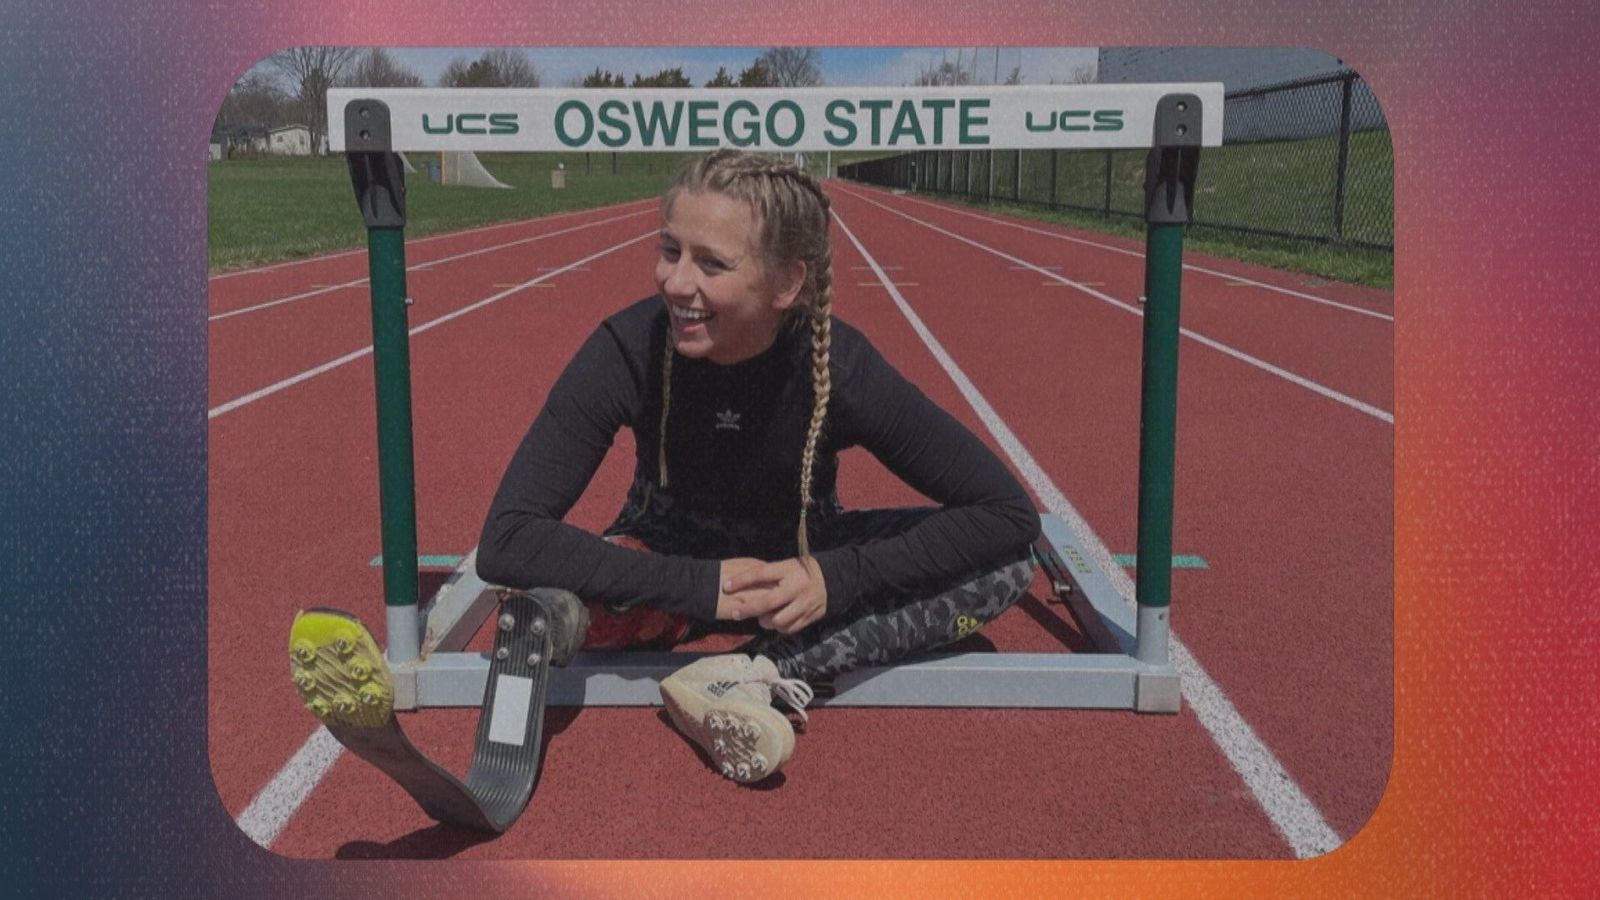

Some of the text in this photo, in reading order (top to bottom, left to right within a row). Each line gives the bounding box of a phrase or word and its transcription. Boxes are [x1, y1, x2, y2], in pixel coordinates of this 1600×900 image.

[423, 113, 519, 134] UCS
[554, 98, 990, 147] OSWEGO STATE
[1025, 110, 1124, 131] UCS
